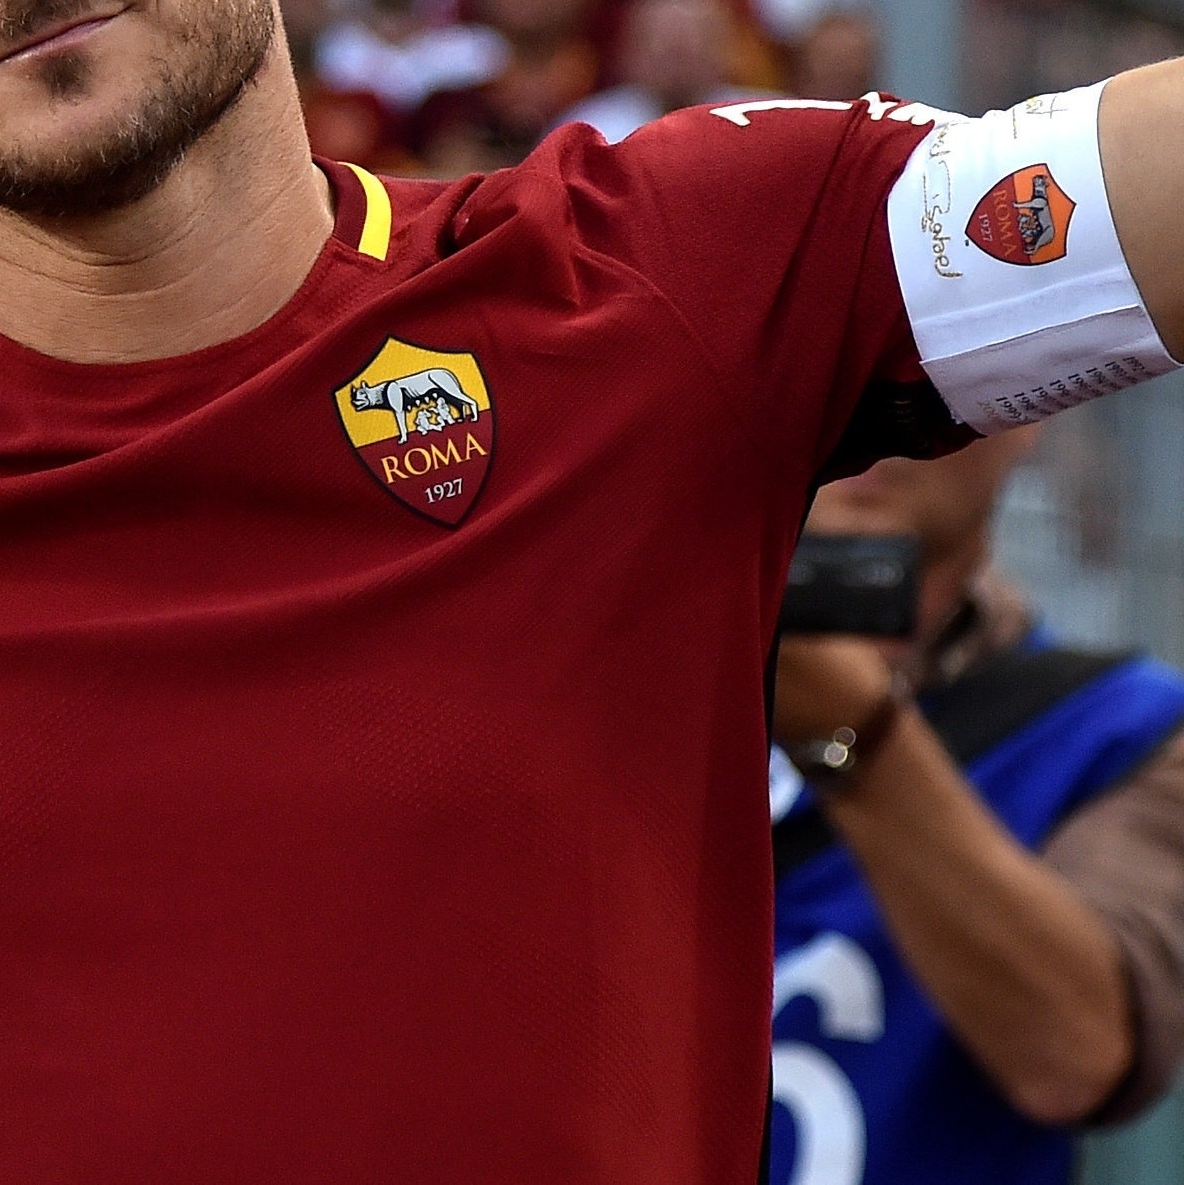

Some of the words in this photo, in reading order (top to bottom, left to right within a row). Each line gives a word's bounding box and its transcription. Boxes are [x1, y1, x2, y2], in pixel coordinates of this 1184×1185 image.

[978, 213, 993, 242] 1927
[992, 189, 1017, 257] ROMA
[380, 432, 488, 484] ROMA
[424, 477, 464, 504] 1927
